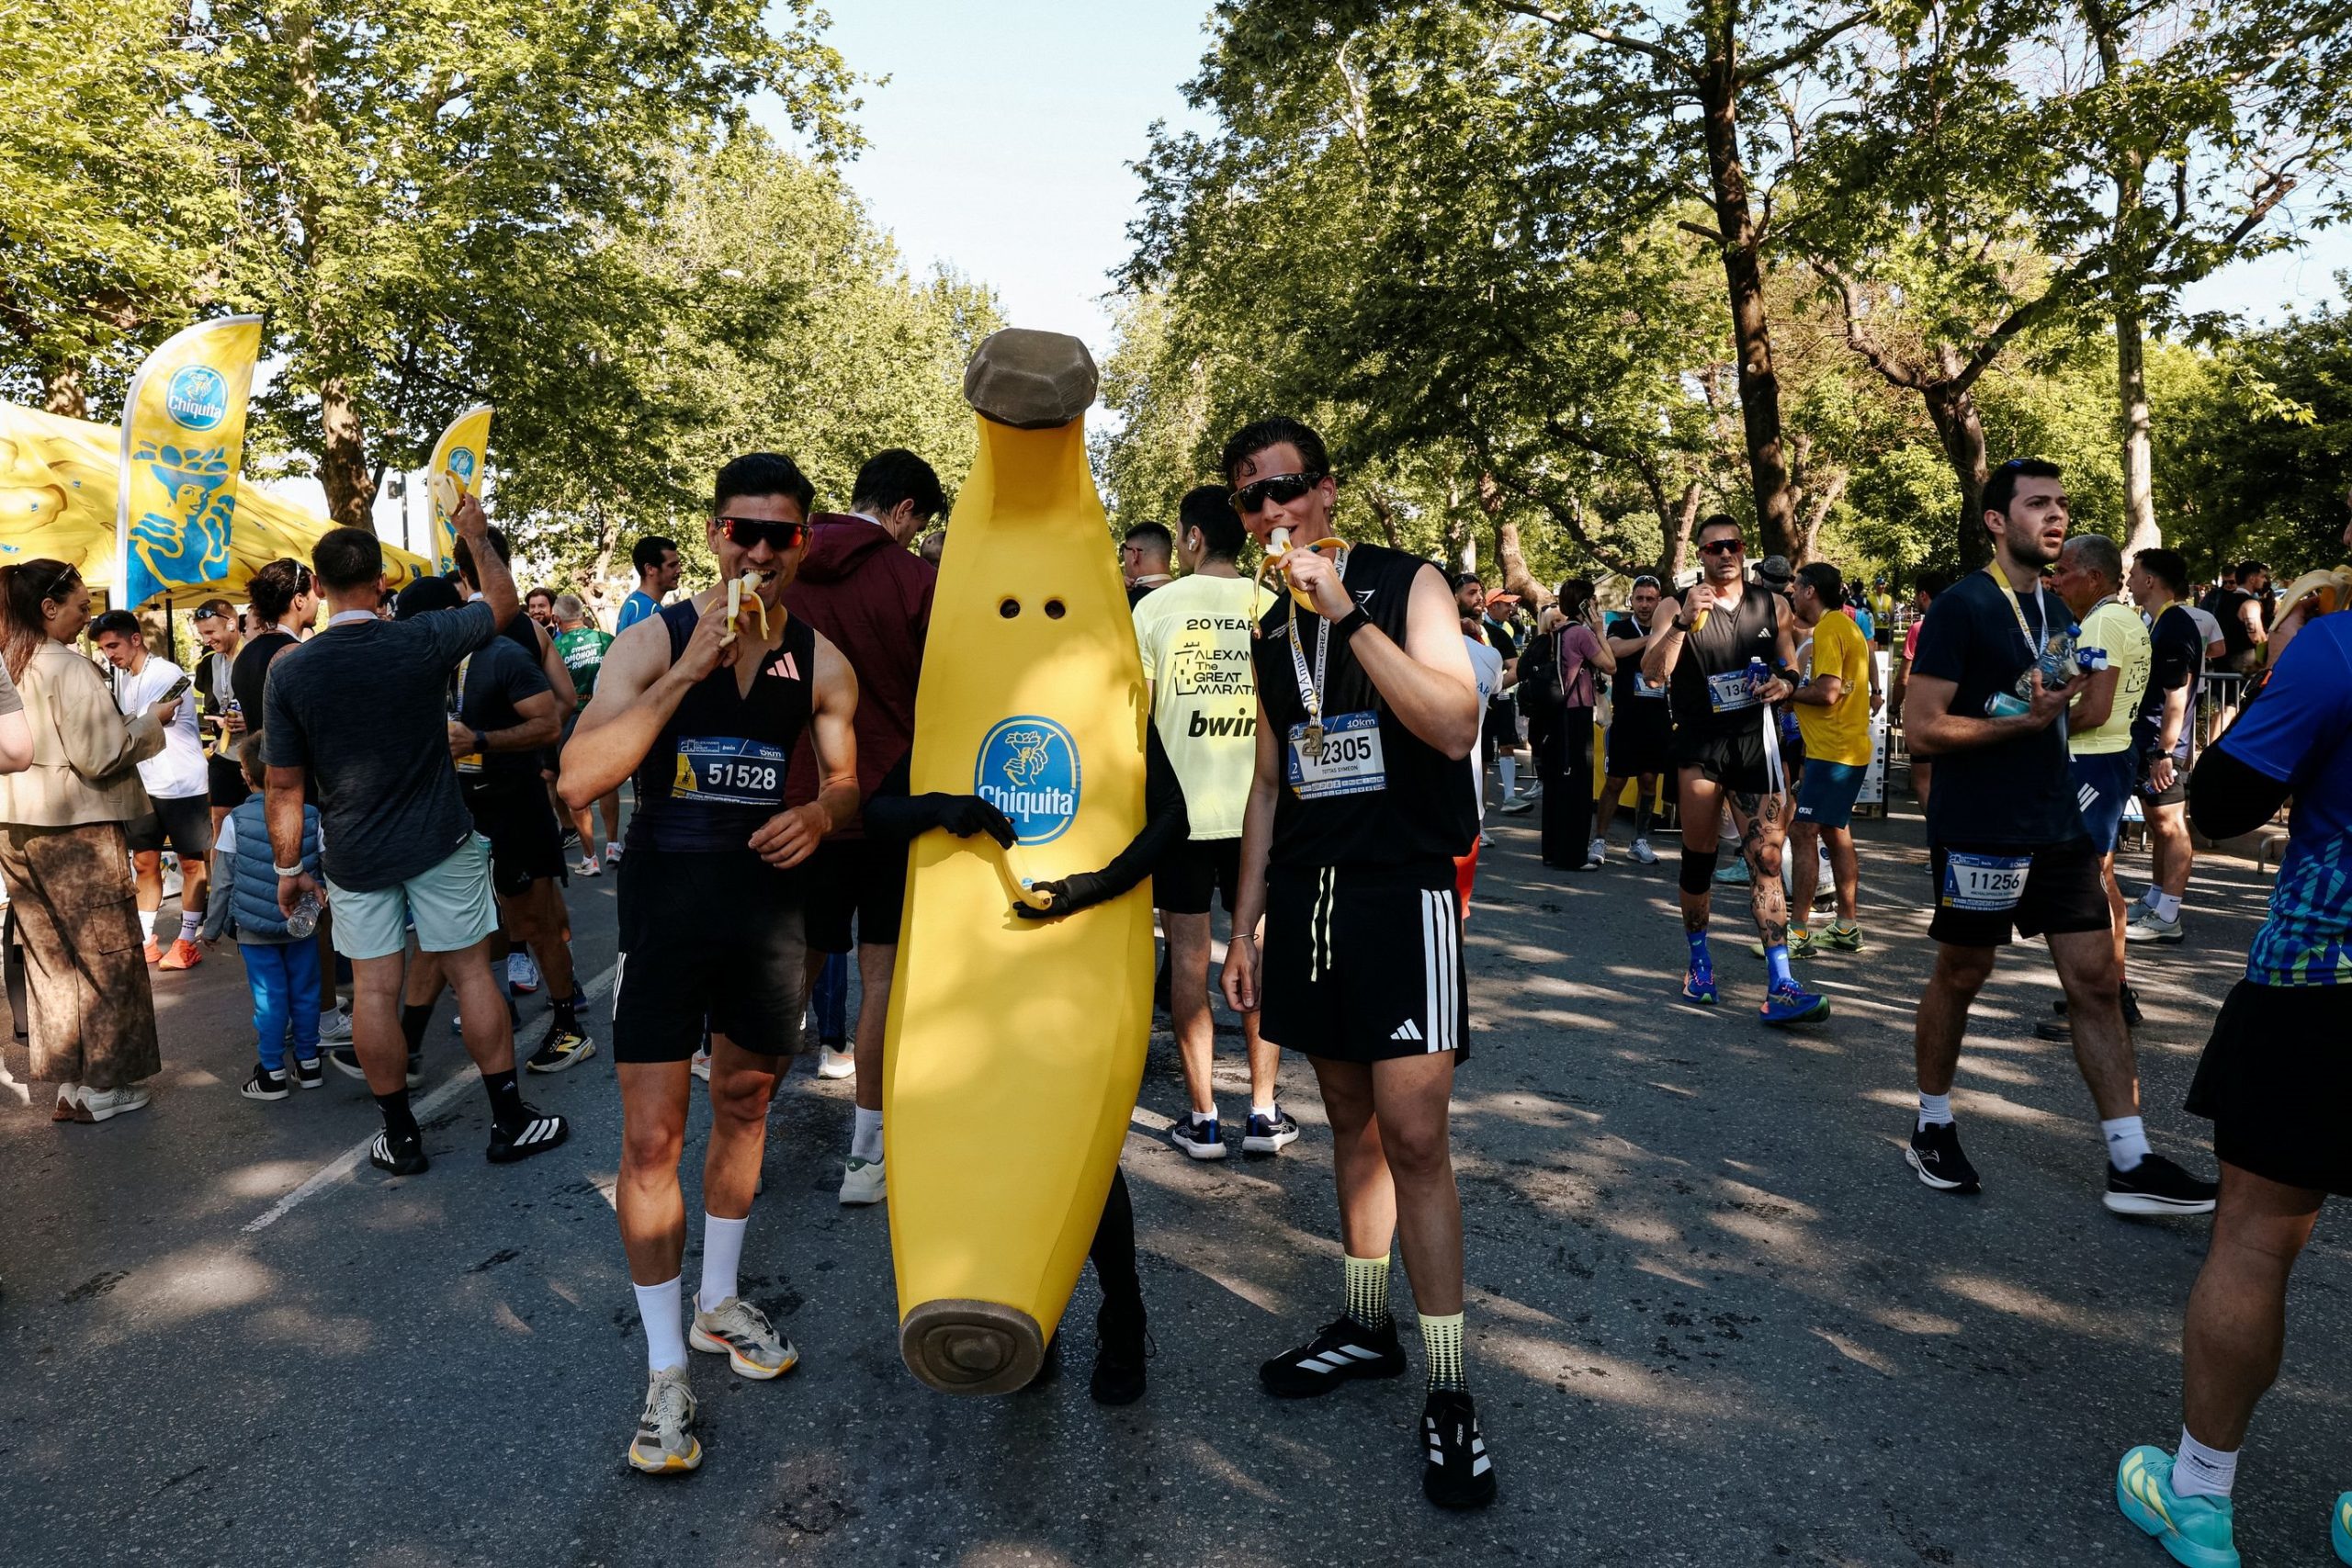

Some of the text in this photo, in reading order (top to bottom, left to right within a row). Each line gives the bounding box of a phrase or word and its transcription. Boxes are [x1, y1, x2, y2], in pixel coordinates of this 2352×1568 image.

[168, 395, 221, 420] Chiquita
[1186, 619, 1211, 630] 20
[1318, 623, 1328, 657] GREAT
[1195, 661, 1218, 671] The
[1193, 672, 1242, 682] GREAT
[1347, 718, 1375, 728] 10km
[707, 763, 776, 790] 51528
[1970, 872, 2020, 890] 11256
